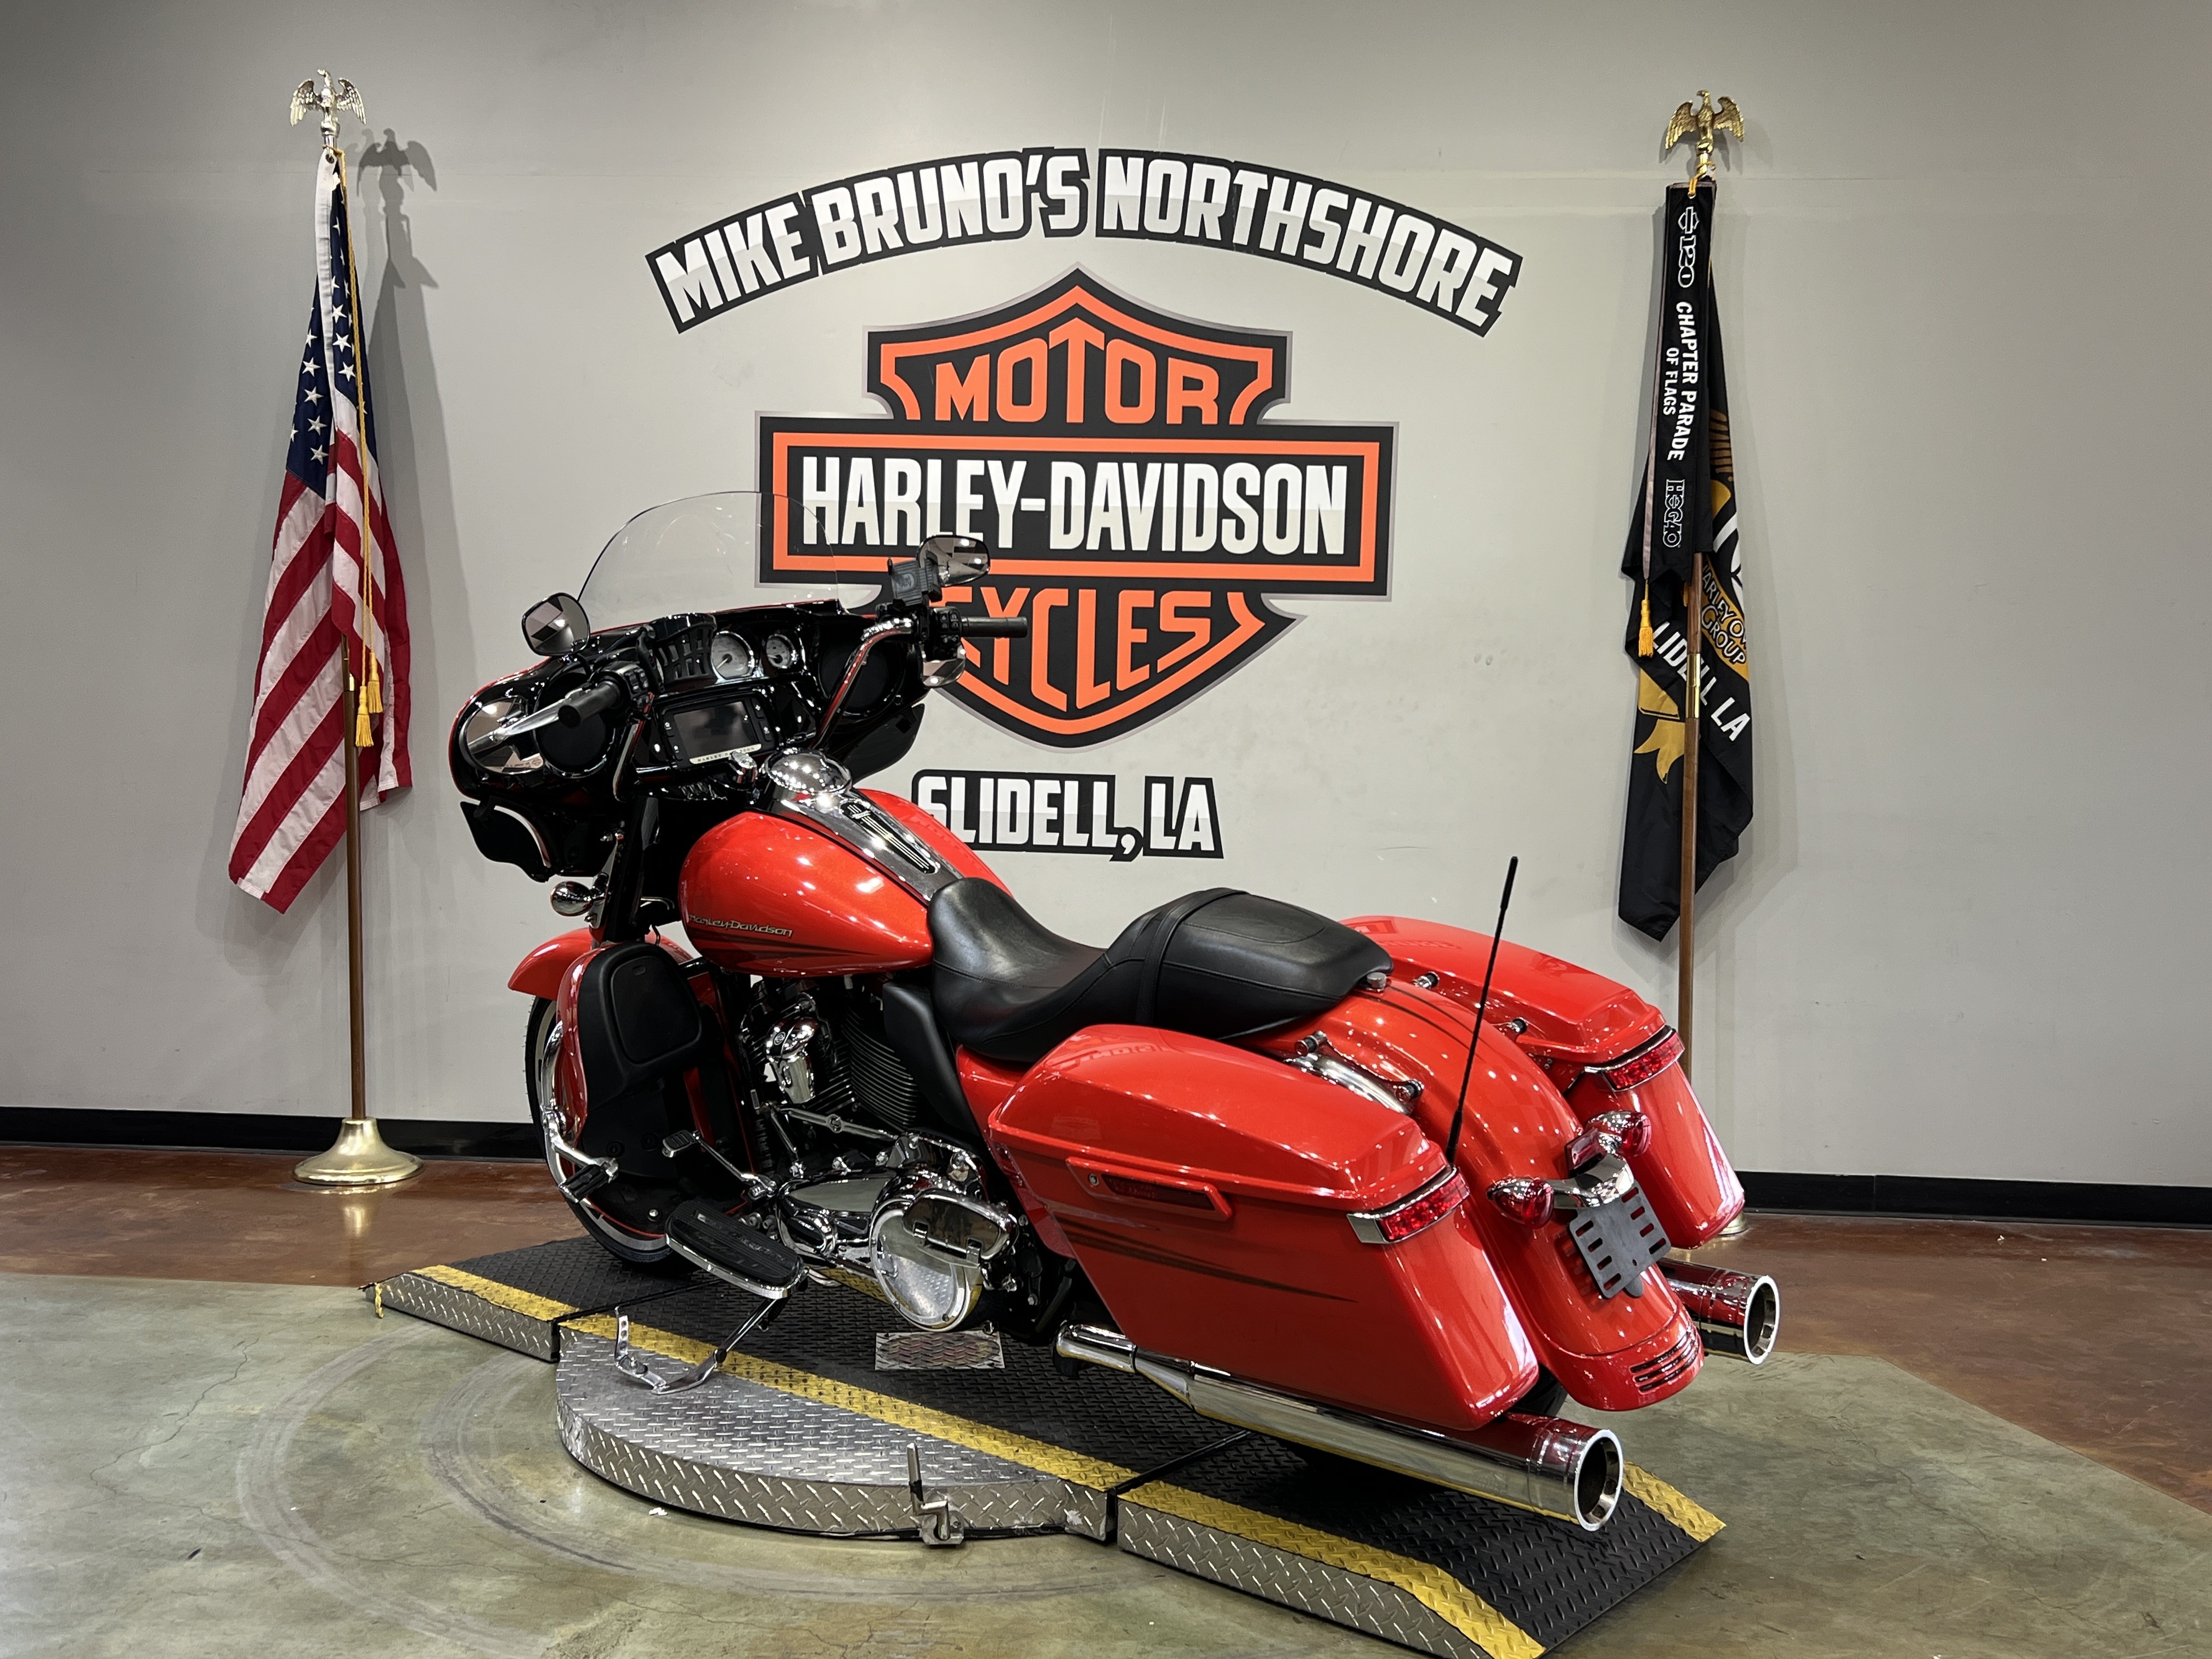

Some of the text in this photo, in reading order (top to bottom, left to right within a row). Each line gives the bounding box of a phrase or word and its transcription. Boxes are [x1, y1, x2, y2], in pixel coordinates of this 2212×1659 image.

[656, 156, 1513, 326] MIKE BRUNO'S NORTHSHORE
[1678, 235, 1696, 287] 120
[936, 319, 1218, 424] MOTOR
[1663, 348, 1679, 415] OF FLAGS
[1667, 302, 1699, 460] CHAPTER PARADE
[803, 456, 1347, 555] HARLEY-DAVIDSON
[1701, 605, 1746, 663] GROUP
[1711, 697, 1750, 741] LA
[1150, 783, 1214, 850] LA
